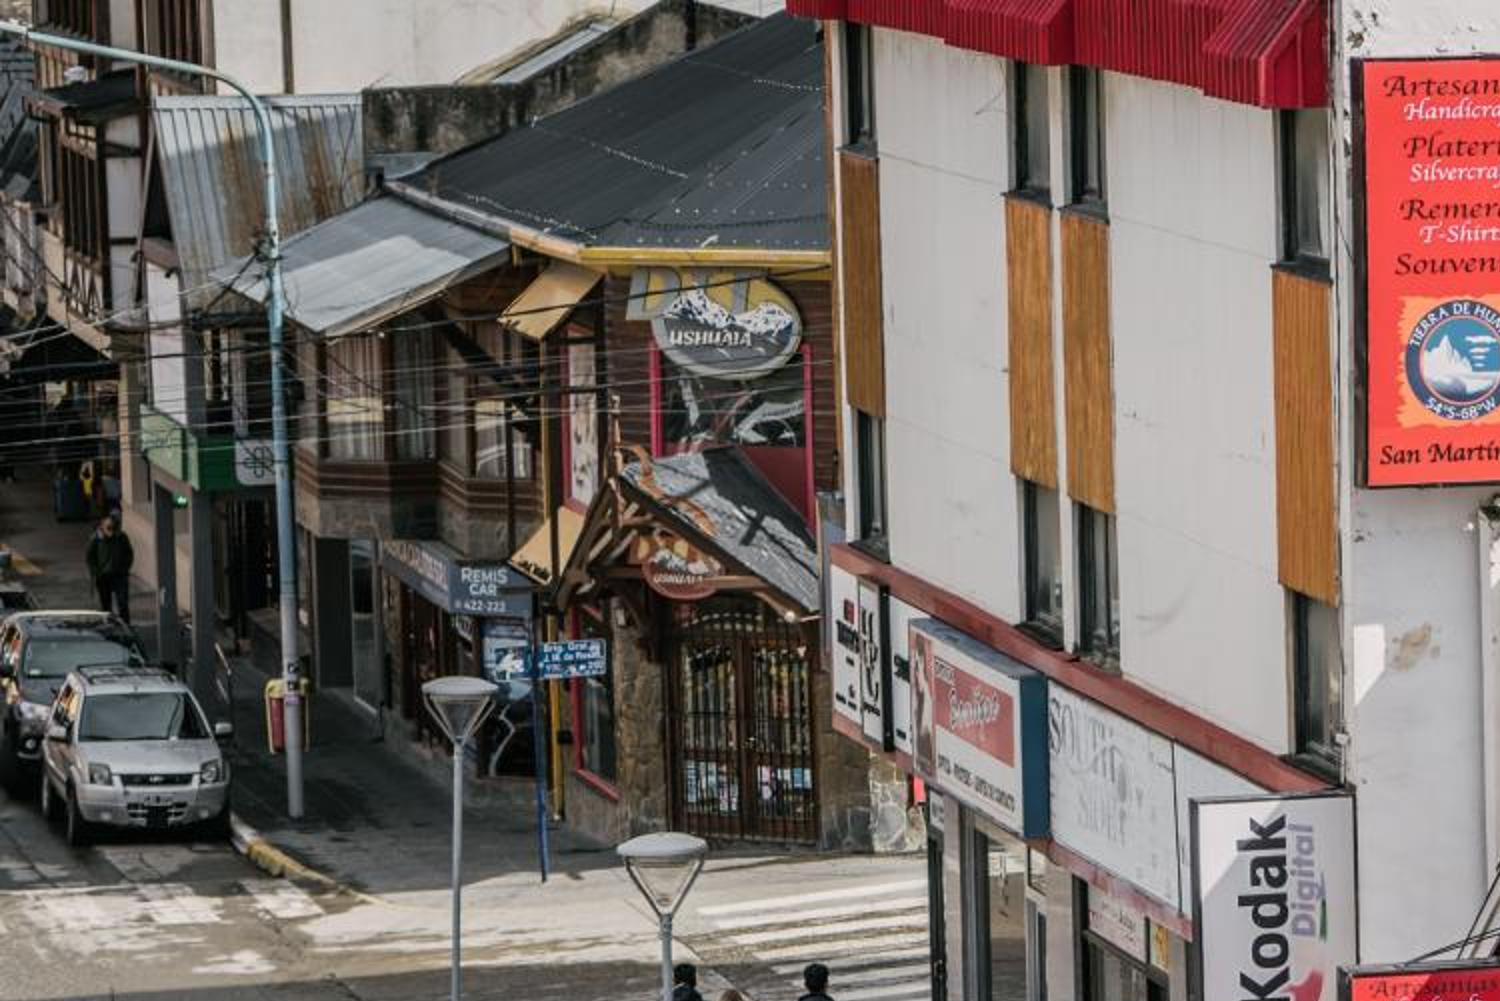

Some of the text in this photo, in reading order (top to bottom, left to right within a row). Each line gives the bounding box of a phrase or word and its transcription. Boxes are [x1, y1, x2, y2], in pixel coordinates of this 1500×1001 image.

[1408, 308, 1450, 347] TIERRA
[1453, 302, 1471, 315] DE
[669, 329, 752, 348] USHUAIA
[1379, 444, 1422, 465] San
[461, 567, 508, 584] REMIS
[469, 584, 498, 596] CAR
[1287, 821, 1328, 937] Digital
